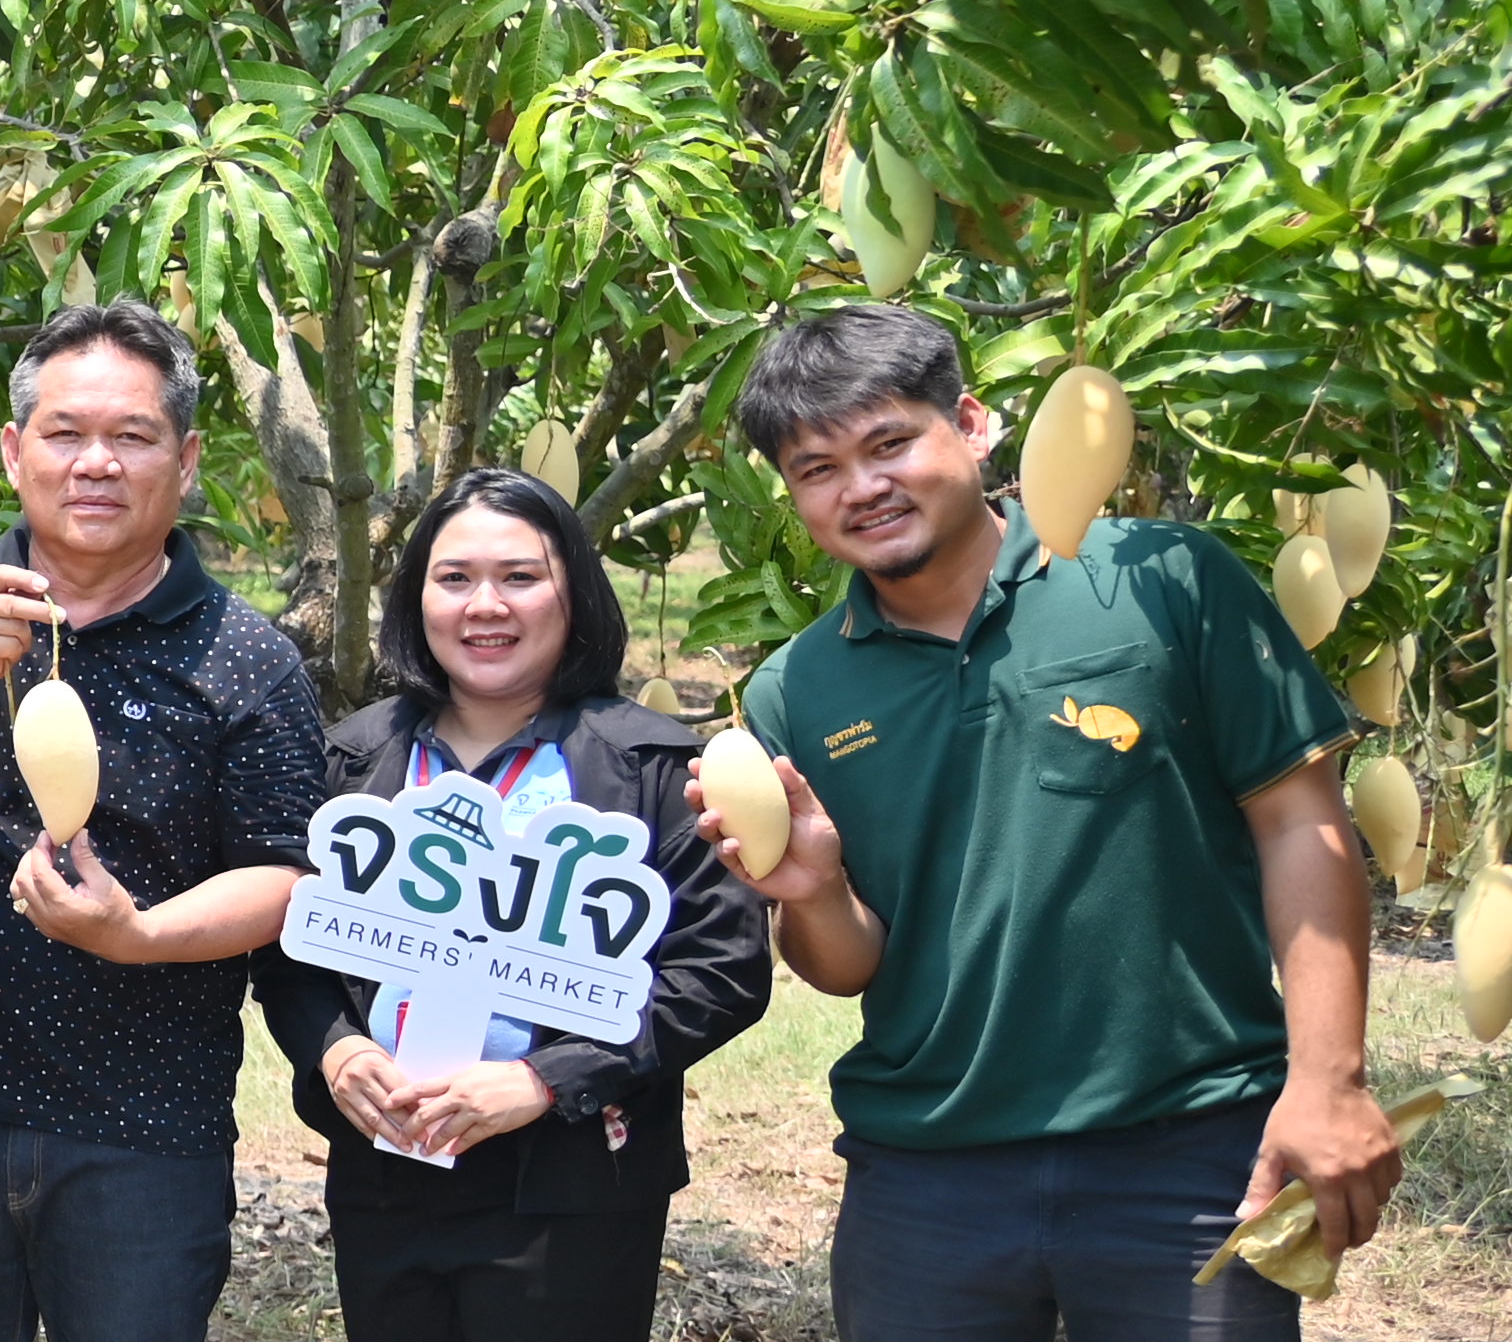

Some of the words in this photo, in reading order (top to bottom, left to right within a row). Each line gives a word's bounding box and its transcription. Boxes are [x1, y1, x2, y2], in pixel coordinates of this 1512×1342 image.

[330, 793, 650, 959] จริงใจ
[305, 910, 472, 967] FARMERS'
[489, 958, 630, 1010] MARKET
